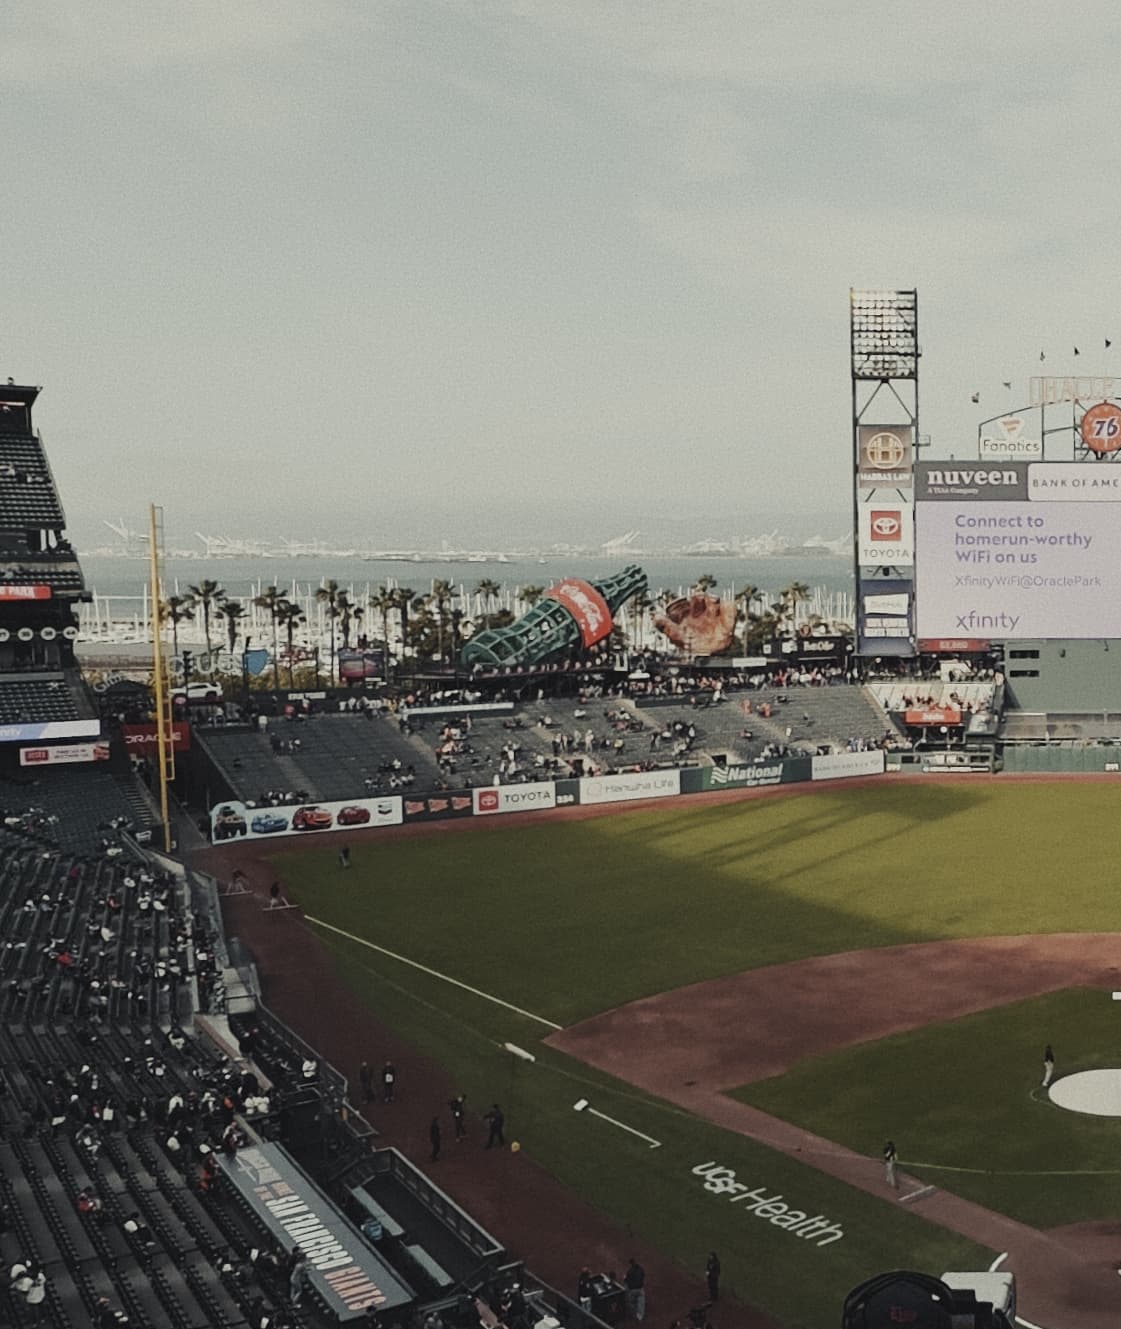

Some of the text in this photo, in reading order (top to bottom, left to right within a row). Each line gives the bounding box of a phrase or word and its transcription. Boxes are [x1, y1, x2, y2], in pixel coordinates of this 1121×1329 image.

[1093, 418, 1120, 438] 76
[983, 440, 1040, 451] Fanatics
[927, 470, 1018, 485] nuveen
[1033, 479, 1067, 487] BANK
[1072, 479, 1086, 487] OF
[955, 515, 1044, 528] Connect to
[955, 533, 1092, 549] homerun-worthy
[864, 550, 910, 558] TOYOTA
[956, 551, 1038, 563] WiFi on us
[955, 576, 1101, 589] XfinityWiFi@OraclePark
[956, 611, 1020, 631] xfinity
[727, 763, 783, 781] National
[505, 791, 551, 804] TOYOTA
[265, 1195, 309, 1218] SAN
[692, 1161, 844, 1246] UCSF Health
[280, 1213, 353, 1270] FRANCISCO
[323, 1266, 387, 1311] GIANTS
